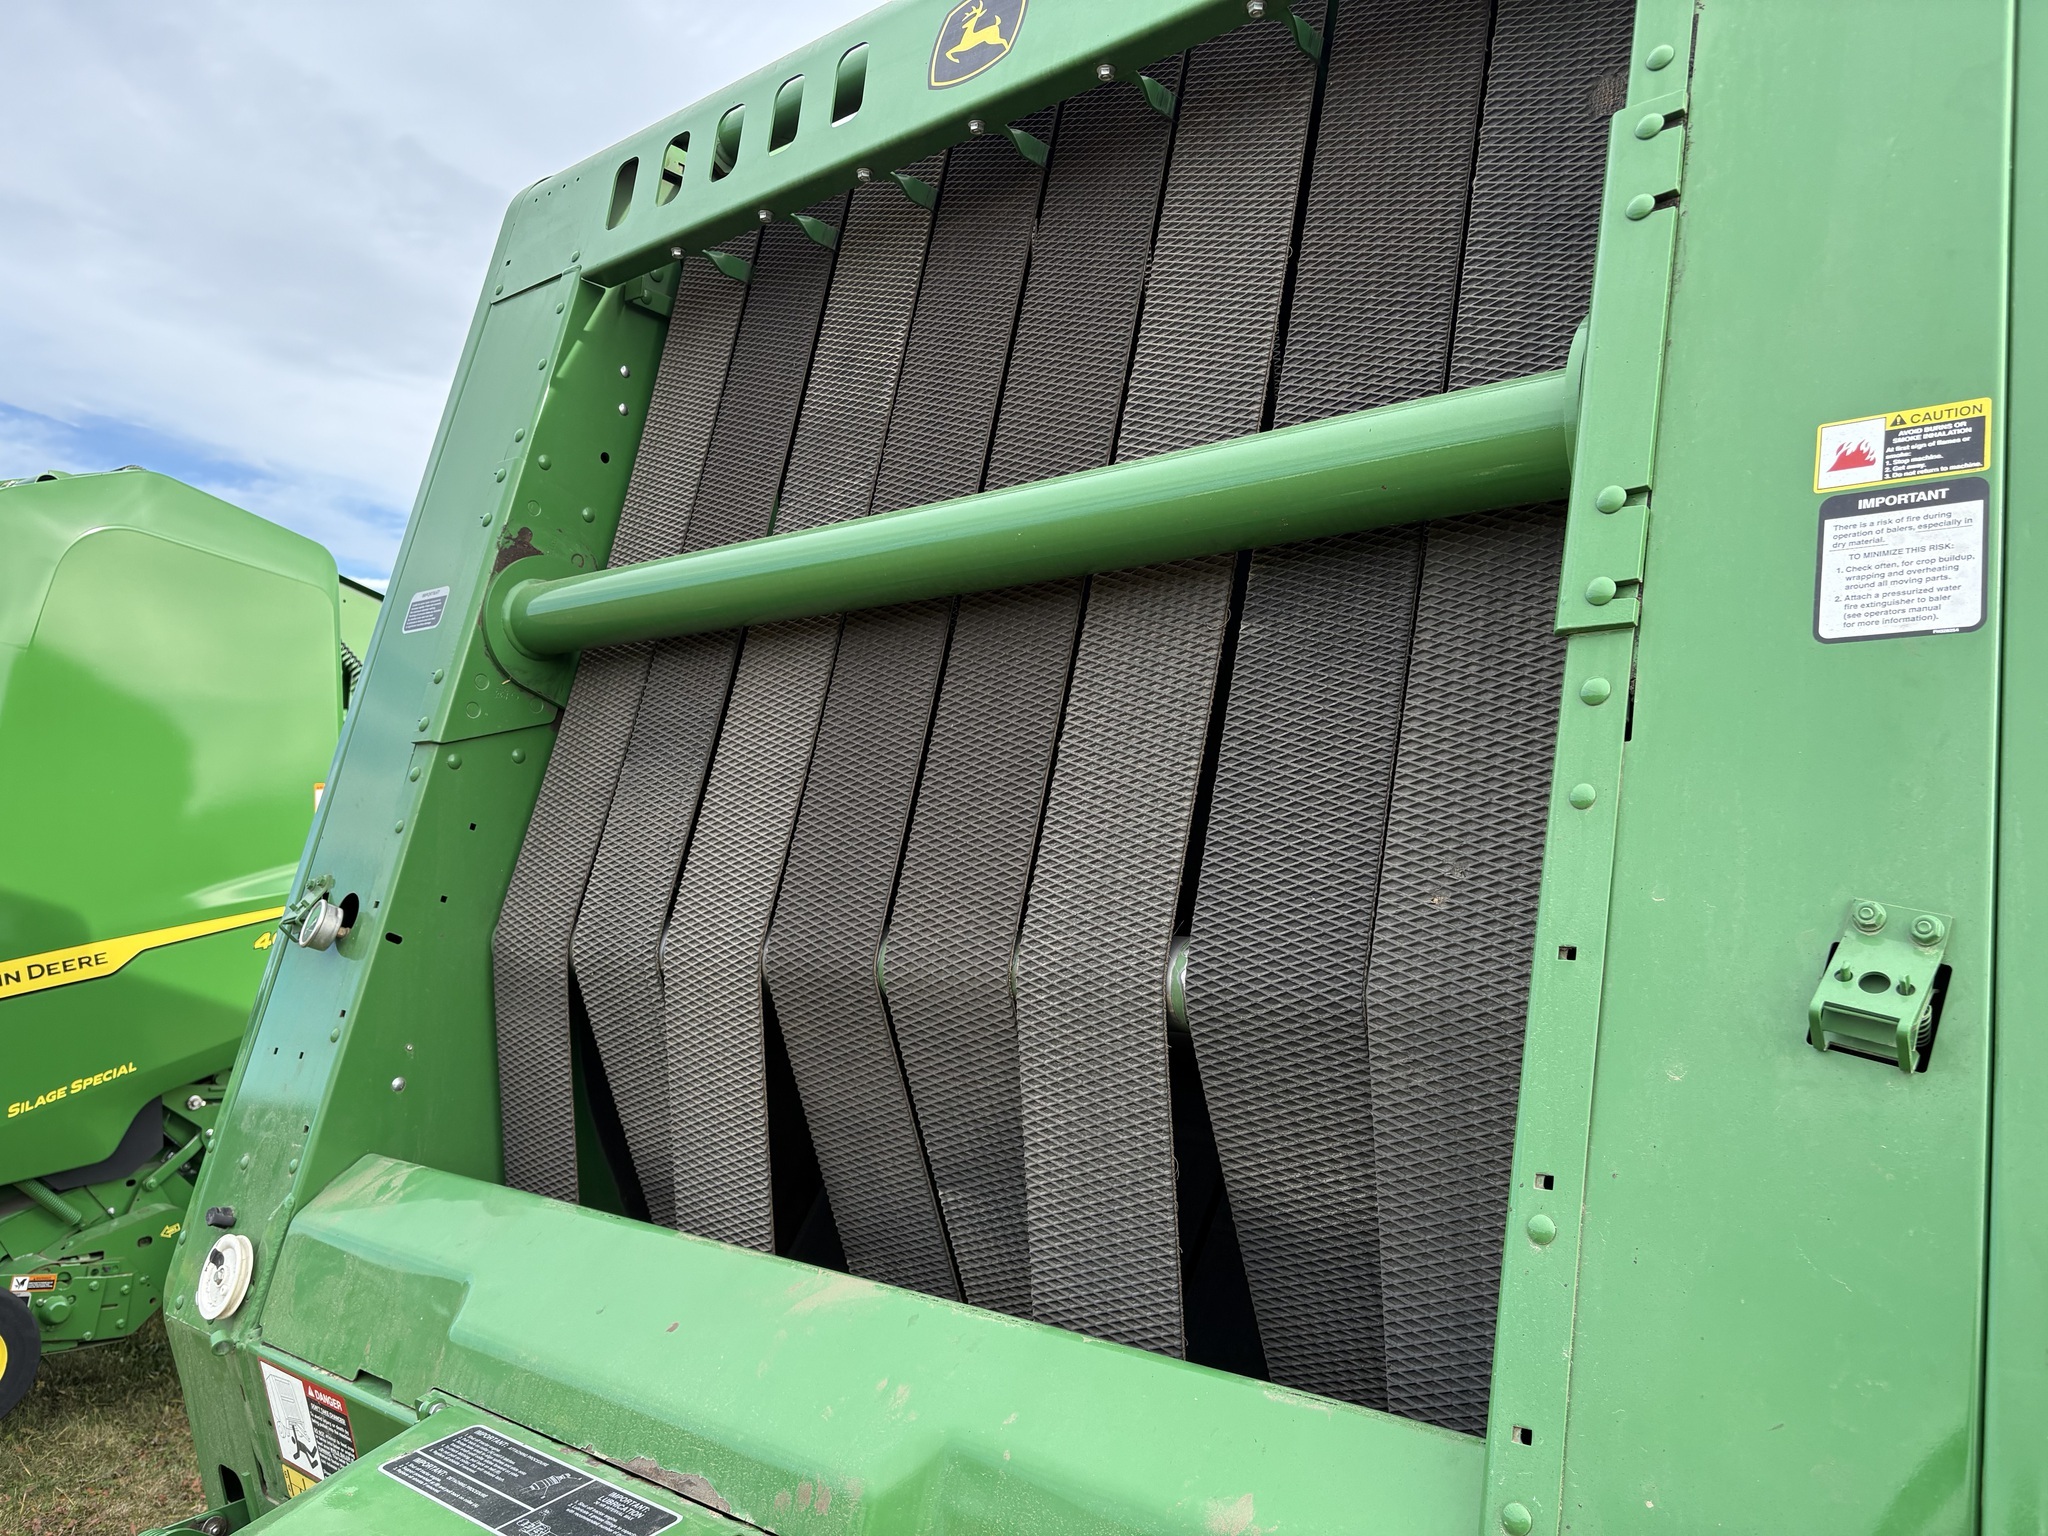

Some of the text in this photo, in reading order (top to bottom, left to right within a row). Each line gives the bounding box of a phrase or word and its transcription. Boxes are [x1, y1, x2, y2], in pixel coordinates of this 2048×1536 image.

[1910, 404, 1982, 423] CAUTION
[1892, 427, 1972, 443] SMOKE INHALATION
[1898, 428, 1923, 436] AVOID
[1924, 423, 1952, 432] BURNS
[1858, 488, 1950, 510] IMPORTANT
[1923, 512, 1952, 520] during
[1832, 530, 1873, 540] operation
[1886, 525, 1915, 533] balers,
[1917, 519, 1961, 529] especially
[1848, 537, 1884, 546] material.
[1863, 548, 1903, 558] MINIMIZE
[1905, 545, 1926, 553] THIS
[1929, 543, 1954, 551] RISK:
[1845, 564, 1872, 572] Check
[1845, 564, 1959, 581] wrapping and overheating
[1844, 581, 1875, 590] around
[1890, 577, 1922, 585] moving
[1925, 574, 1951, 583] parts.
[1844, 593, 1872, 601] Attach
[1882, 587, 1933, 598] pressurized
[1860, 598, 1914, 608] extinguisher
[1843, 604, 1941, 620] (see operators manual
[1882, 614, 1938, 624] information).
[27, 952, 108, 980] DEERE
[8, 1062, 137, 1118] SILAGE SPECIAL
[314, 1389, 343, 1411] DANGER
[597, 1495, 645, 1519] LUBRICATION
[608, 1491, 651, 1513] IMPORTANT:
